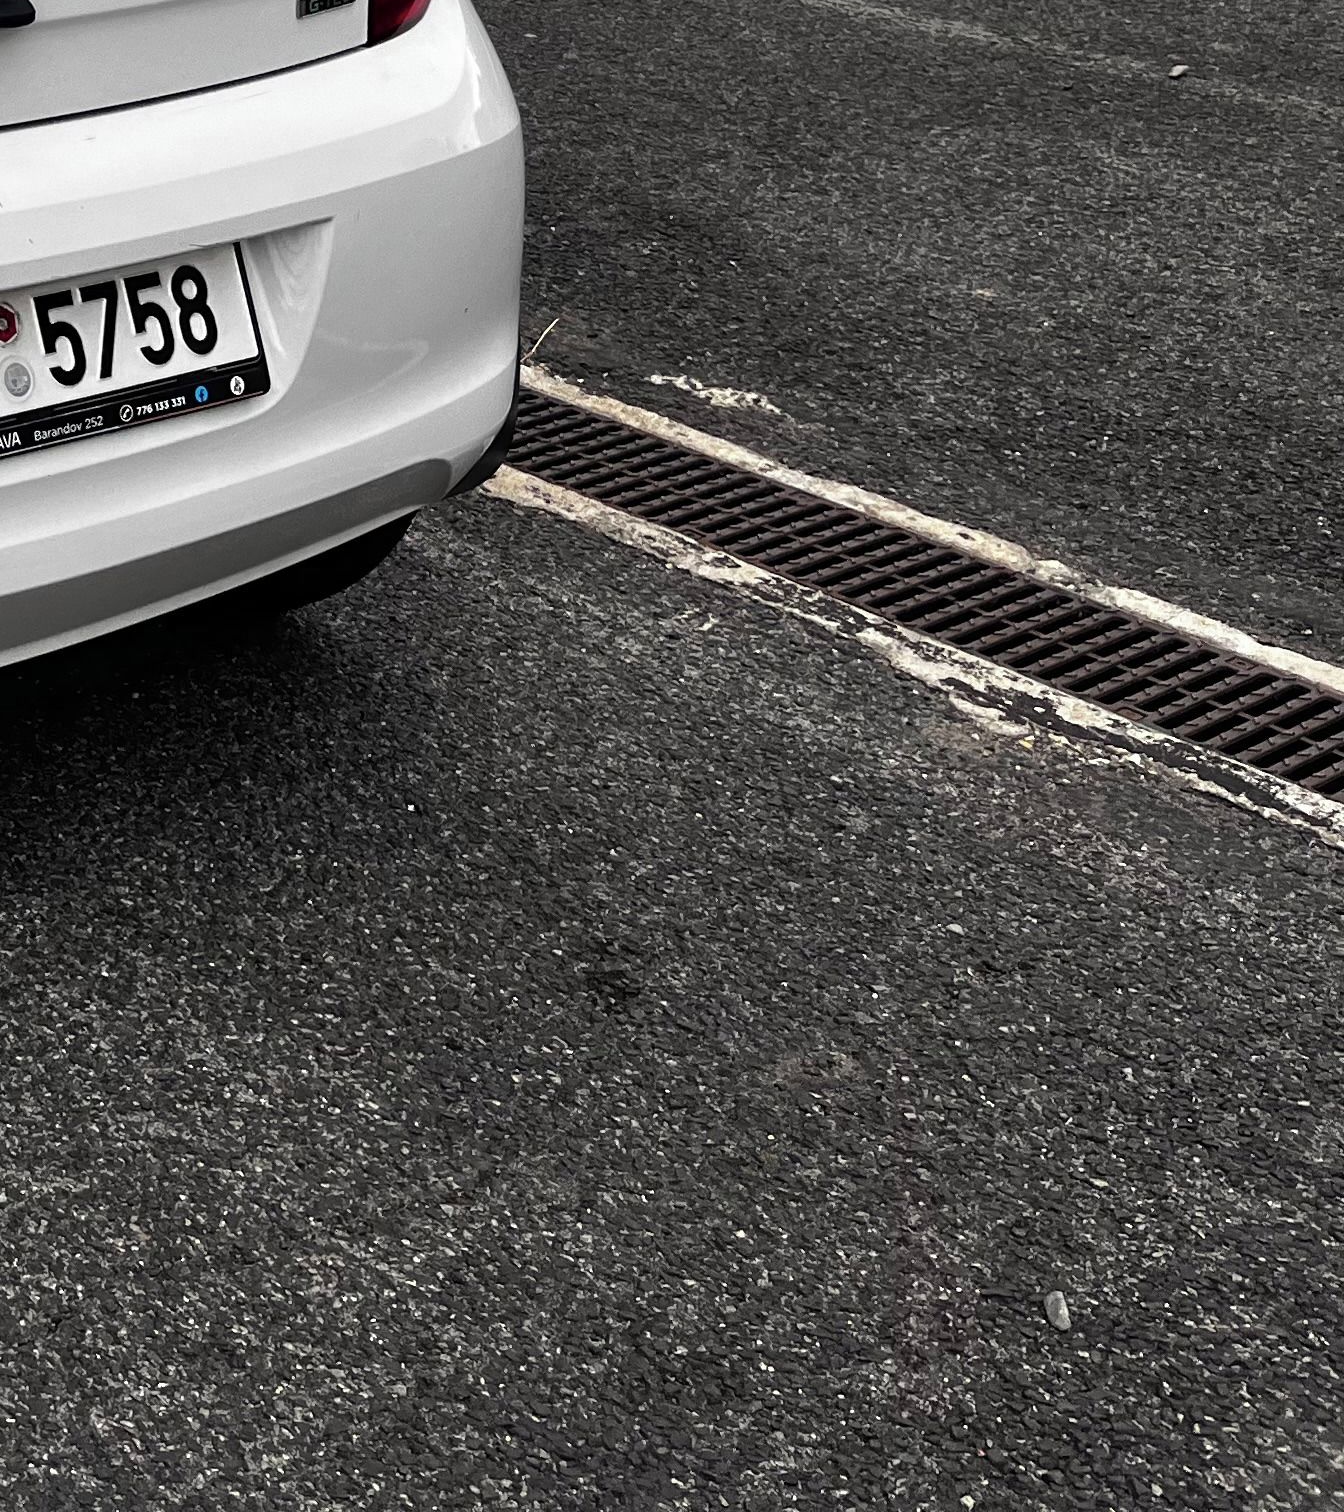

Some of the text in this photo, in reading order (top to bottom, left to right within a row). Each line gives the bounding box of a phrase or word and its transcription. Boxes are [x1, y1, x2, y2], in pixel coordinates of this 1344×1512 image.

[32, 264, 219, 387] 5758
[136, 395, 187, 416] 776 133 331
[33, 415, 104, 441] Barandov 252
